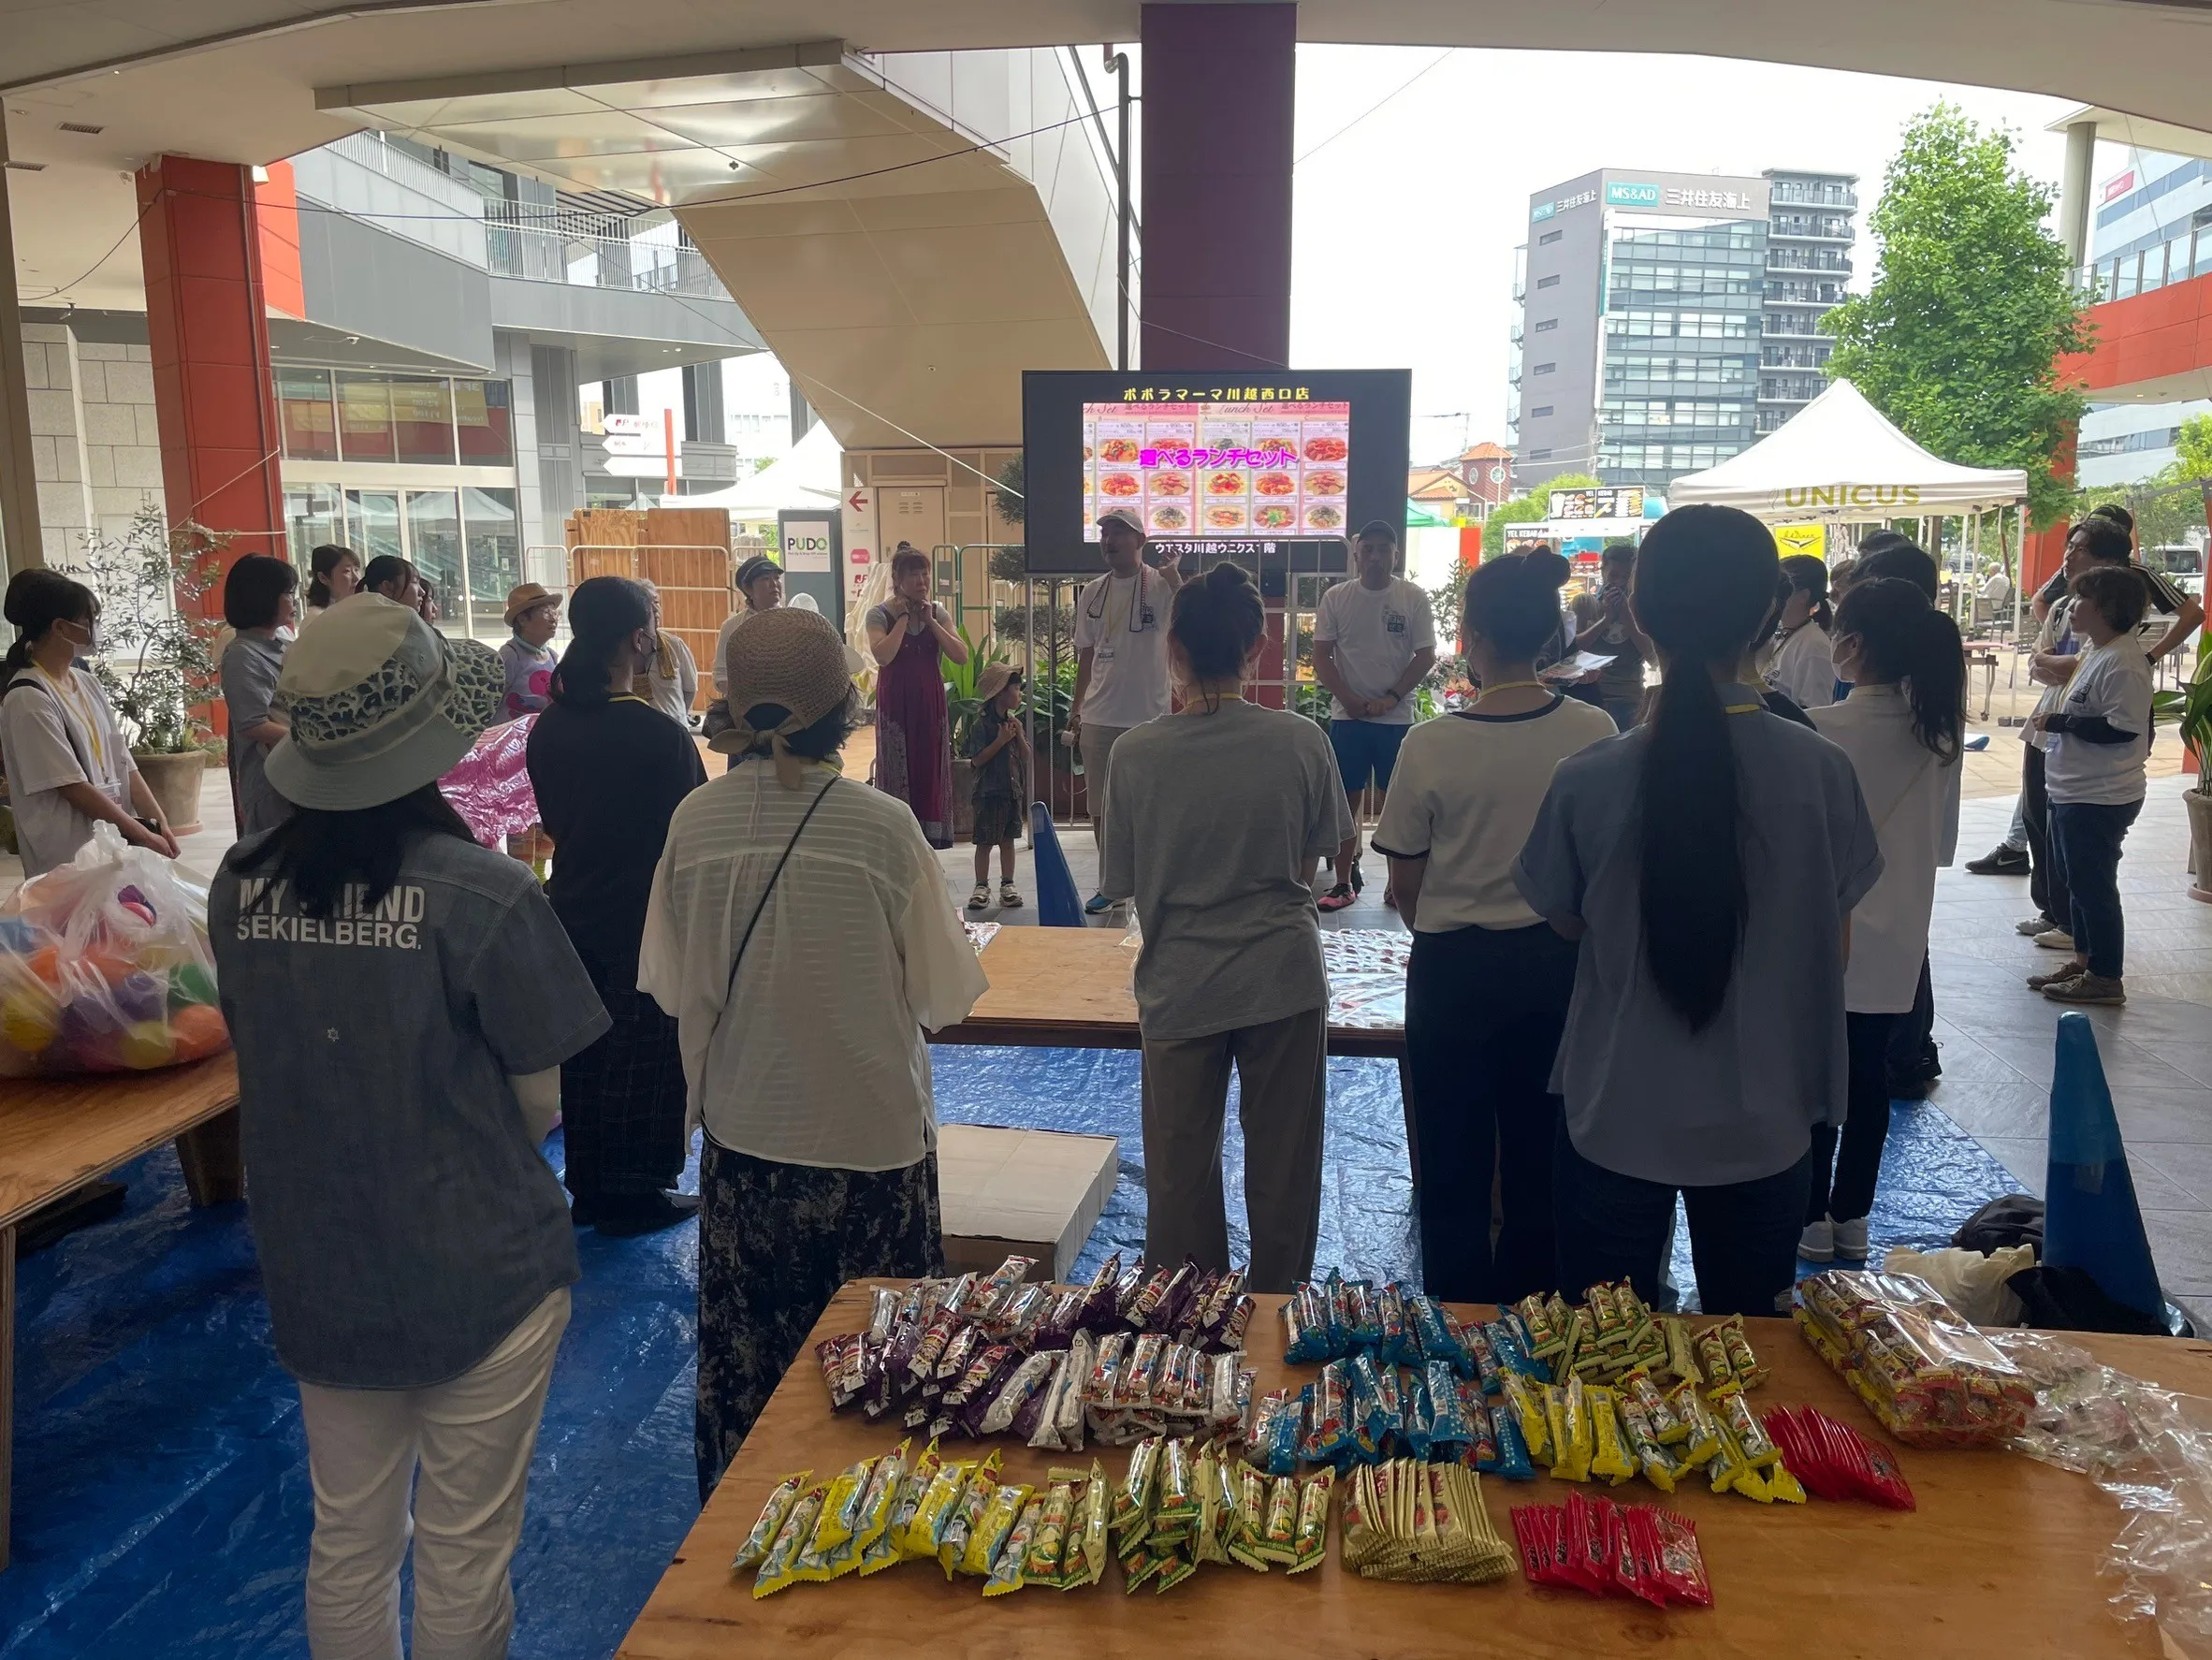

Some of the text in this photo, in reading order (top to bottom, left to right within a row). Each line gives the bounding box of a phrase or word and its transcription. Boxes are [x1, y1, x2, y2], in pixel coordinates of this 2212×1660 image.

[1610, 186, 1656, 201] MS&AD
[1665, 188, 1752, 211] 三井住友海上
[1784, 485, 1920, 507] UNICUS
[788, 537, 827, 550] PUDO
[239, 878, 425, 923] MY IEND
[237, 915, 422, 950] SEKIELBERG.
